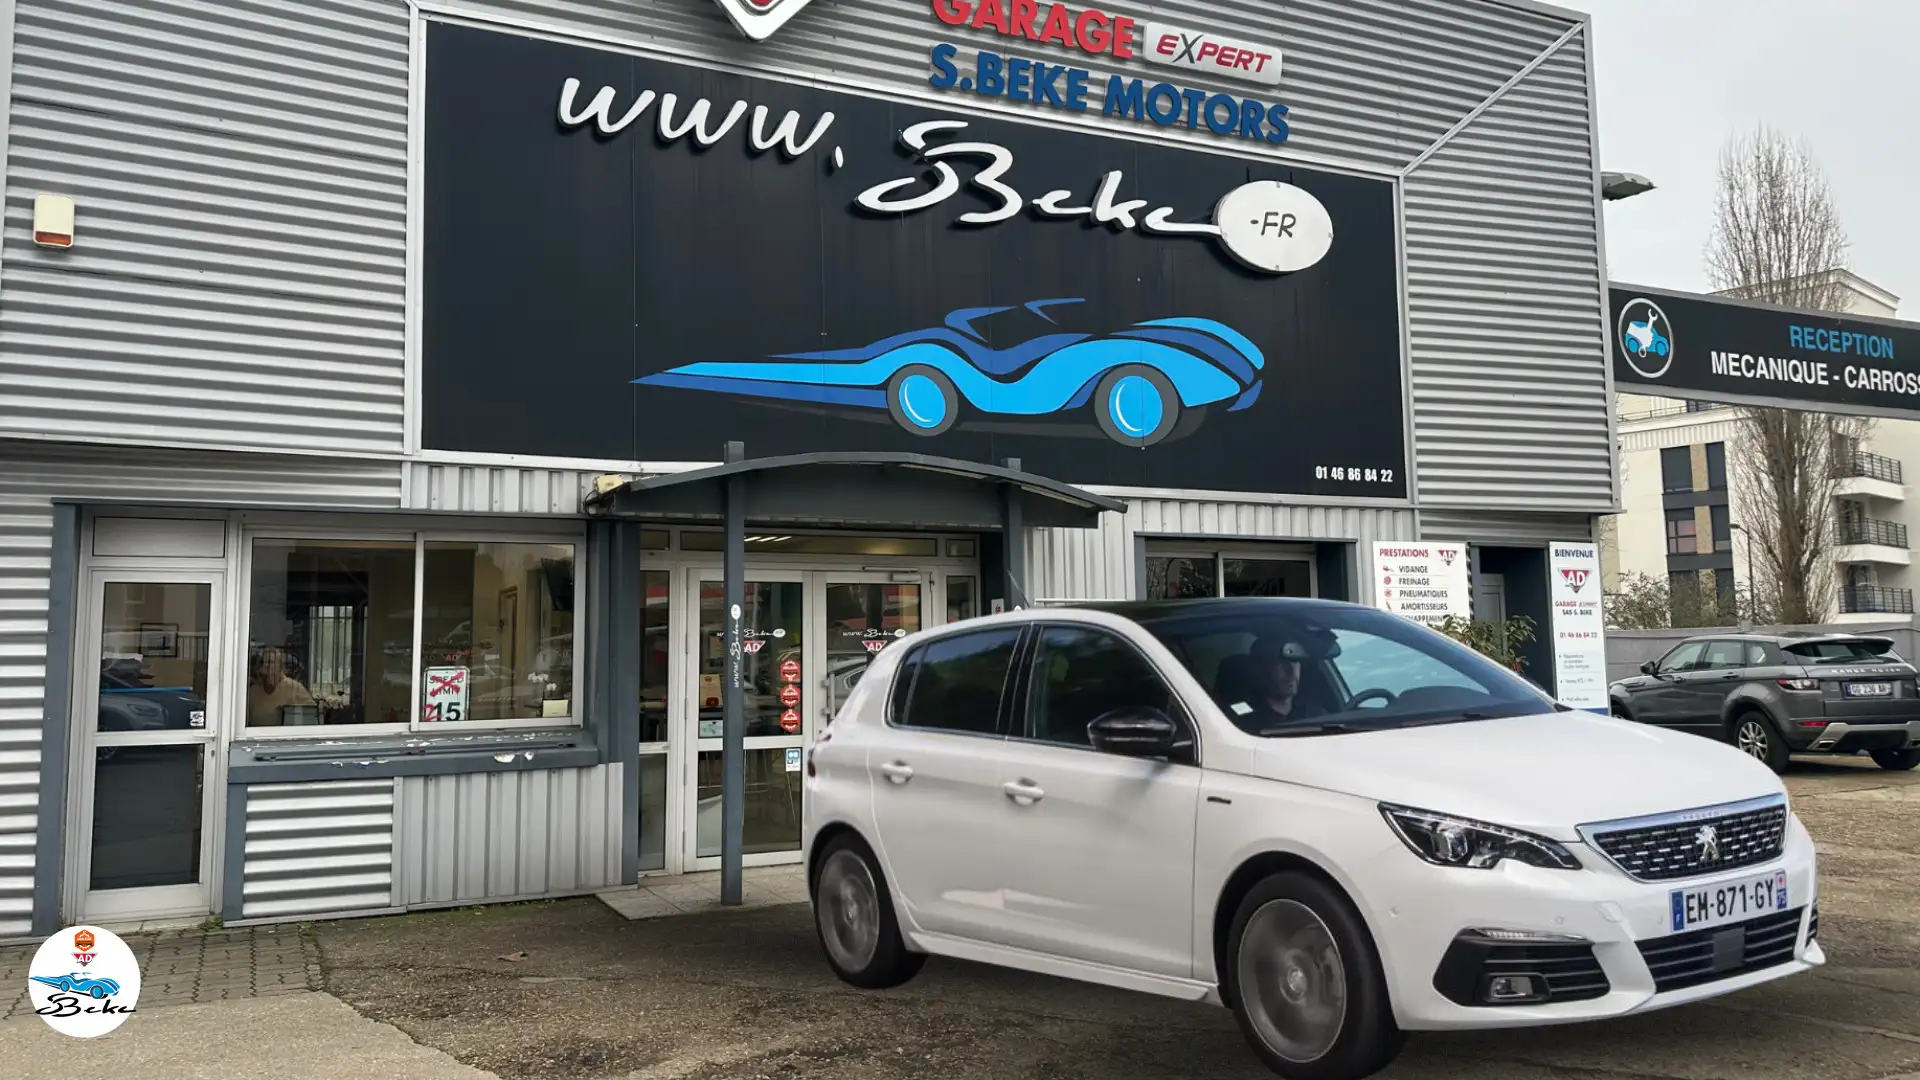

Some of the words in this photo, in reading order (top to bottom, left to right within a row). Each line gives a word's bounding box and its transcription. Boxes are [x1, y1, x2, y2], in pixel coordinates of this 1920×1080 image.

[932, 0, 1135, 60] GARAGE
[929, 44, 1090, 113] S.BEKE
[1102, 75, 1291, 144] MOTORS
[1789, 325, 1894, 359] RECEPTION
[1710, 351, 1829, 386] MECANIQUE
[1844, 366, 1920, 396] CARROS
[1315, 465, 1328, 480] 01
[1331, 467, 1345, 481] 46
[1348, 468, 1361, 482] 86
[1364, 468, 1378, 482] 84
[1381, 469, 1394, 483] 22
[1379, 548, 1429, 558] PRESTATIONS
[1554, 548, 1594, 558] BIENVENUE
[1399, 578, 1430, 586] FREINAGE
[1567, 571, 1586, 586] AD
[1399, 590, 1448, 598] PNEUMATIQUES
[744, 643, 761, 653] AD
[867, 643, 883, 652] AD
[1685, 878, 1774, 925] EM-871-GY
